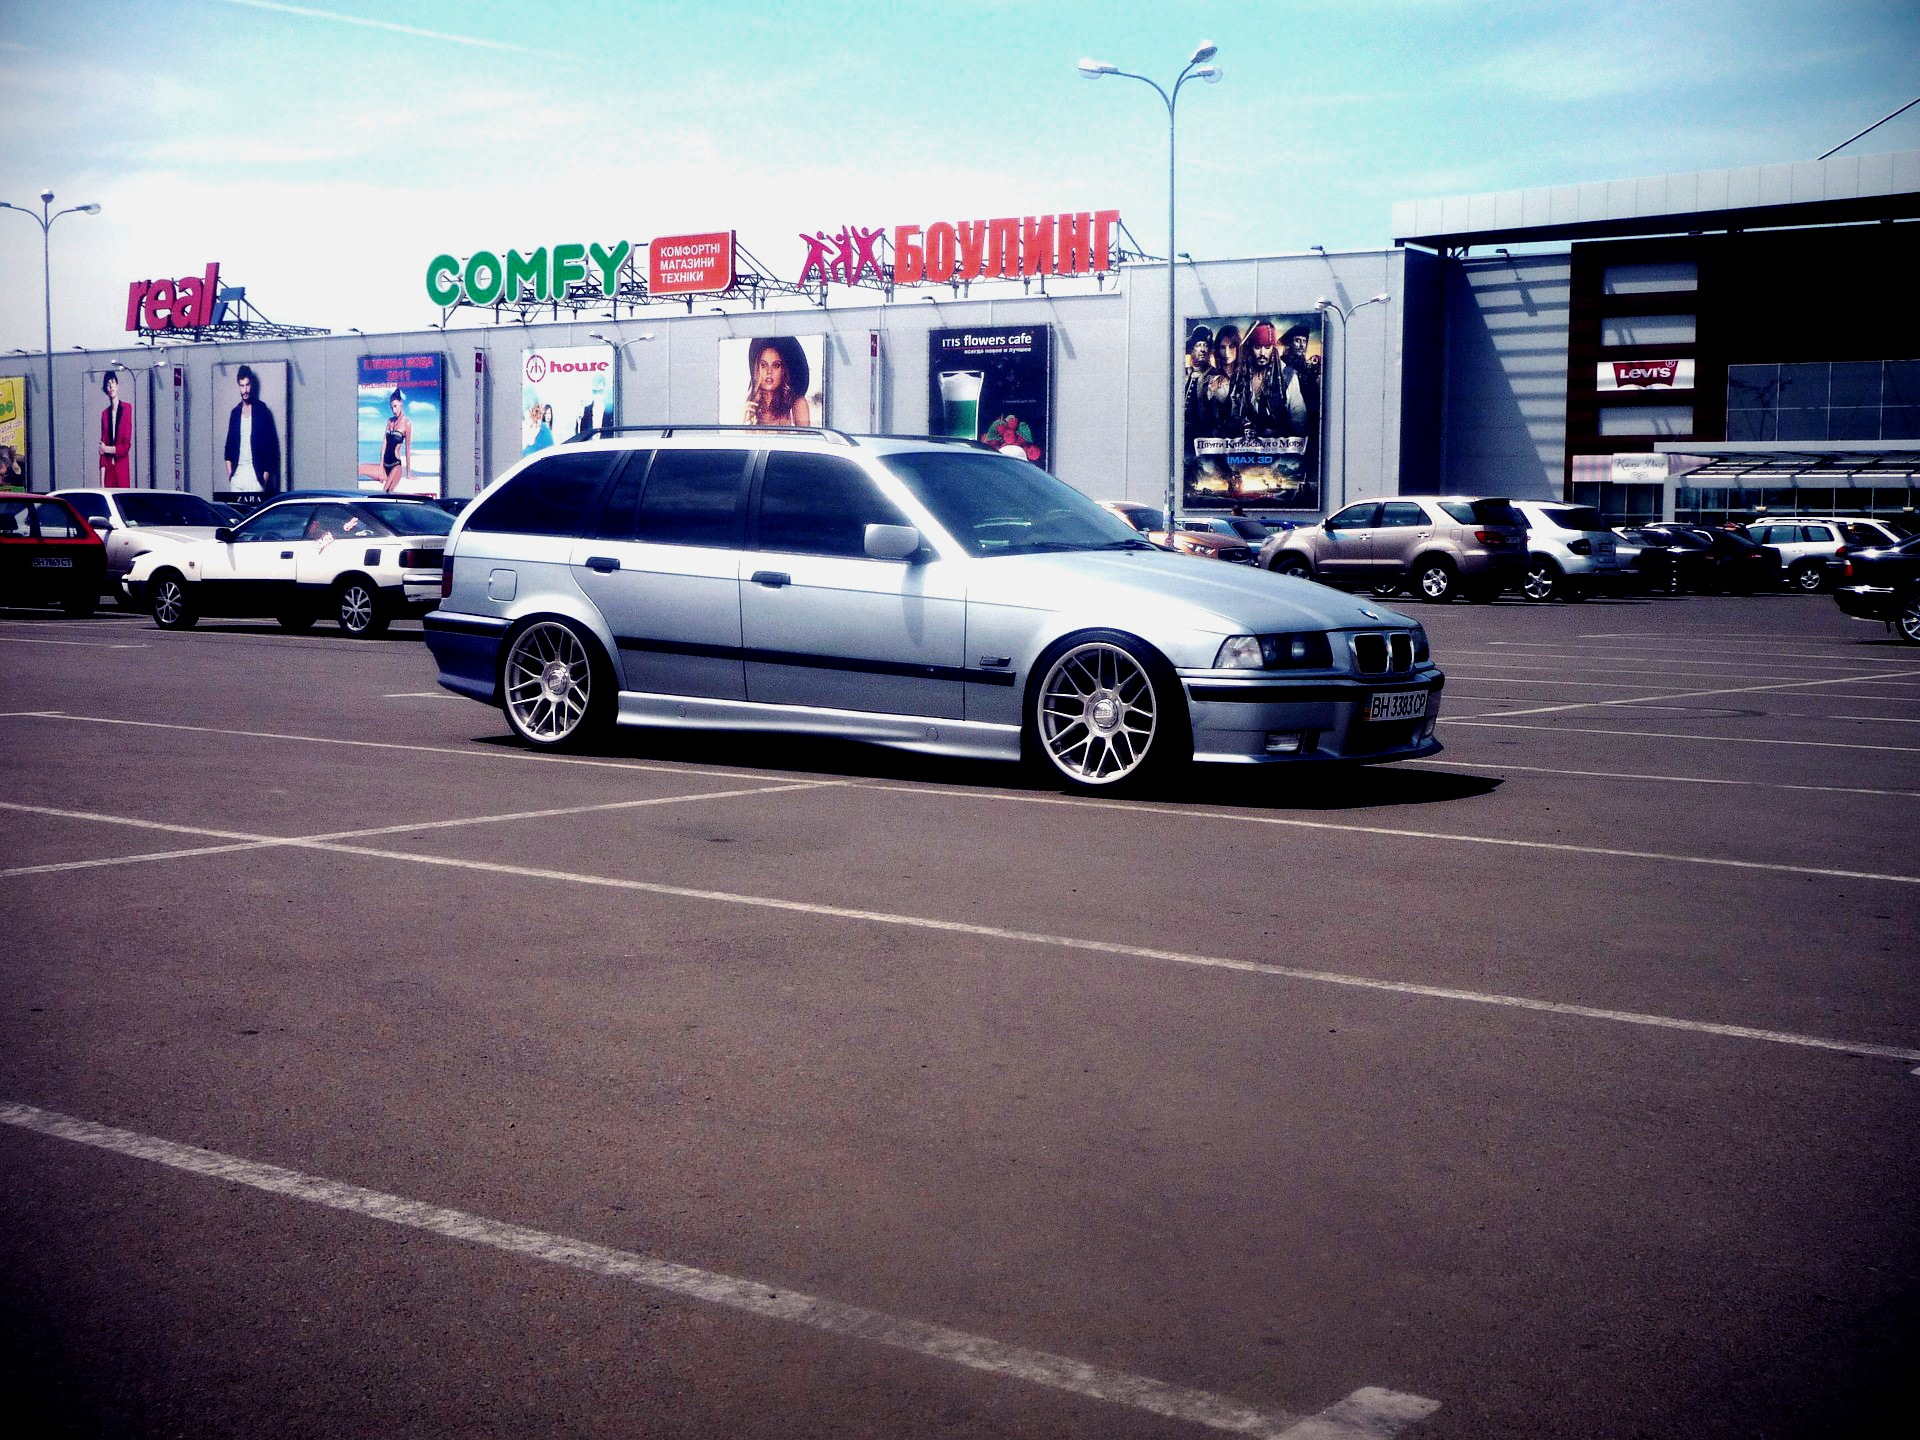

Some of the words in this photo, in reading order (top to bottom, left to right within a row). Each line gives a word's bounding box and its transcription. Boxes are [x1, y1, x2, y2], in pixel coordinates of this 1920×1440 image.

[660, 243, 721, 257] КОМФОРТНІ
[894, 210, 1120, 284] БОУЛИНГ
[660, 257, 715, 270] МАГАЗИНИ
[426, 240, 632, 307] COMFY
[661, 271, 704, 284] ТЕХНІКИ
[126, 262, 220, 331] real
[964, 334, 1006, 346] flowers
[1008, 332, 1032, 344] cafe
[550, 361, 609, 373] house
[1227, 456, 1254, 465] IMAX
[1257, 456, 1273, 464] 3D
[1372, 697, 1390, 718] BH
[1391, 695, 1414, 716] 3383
